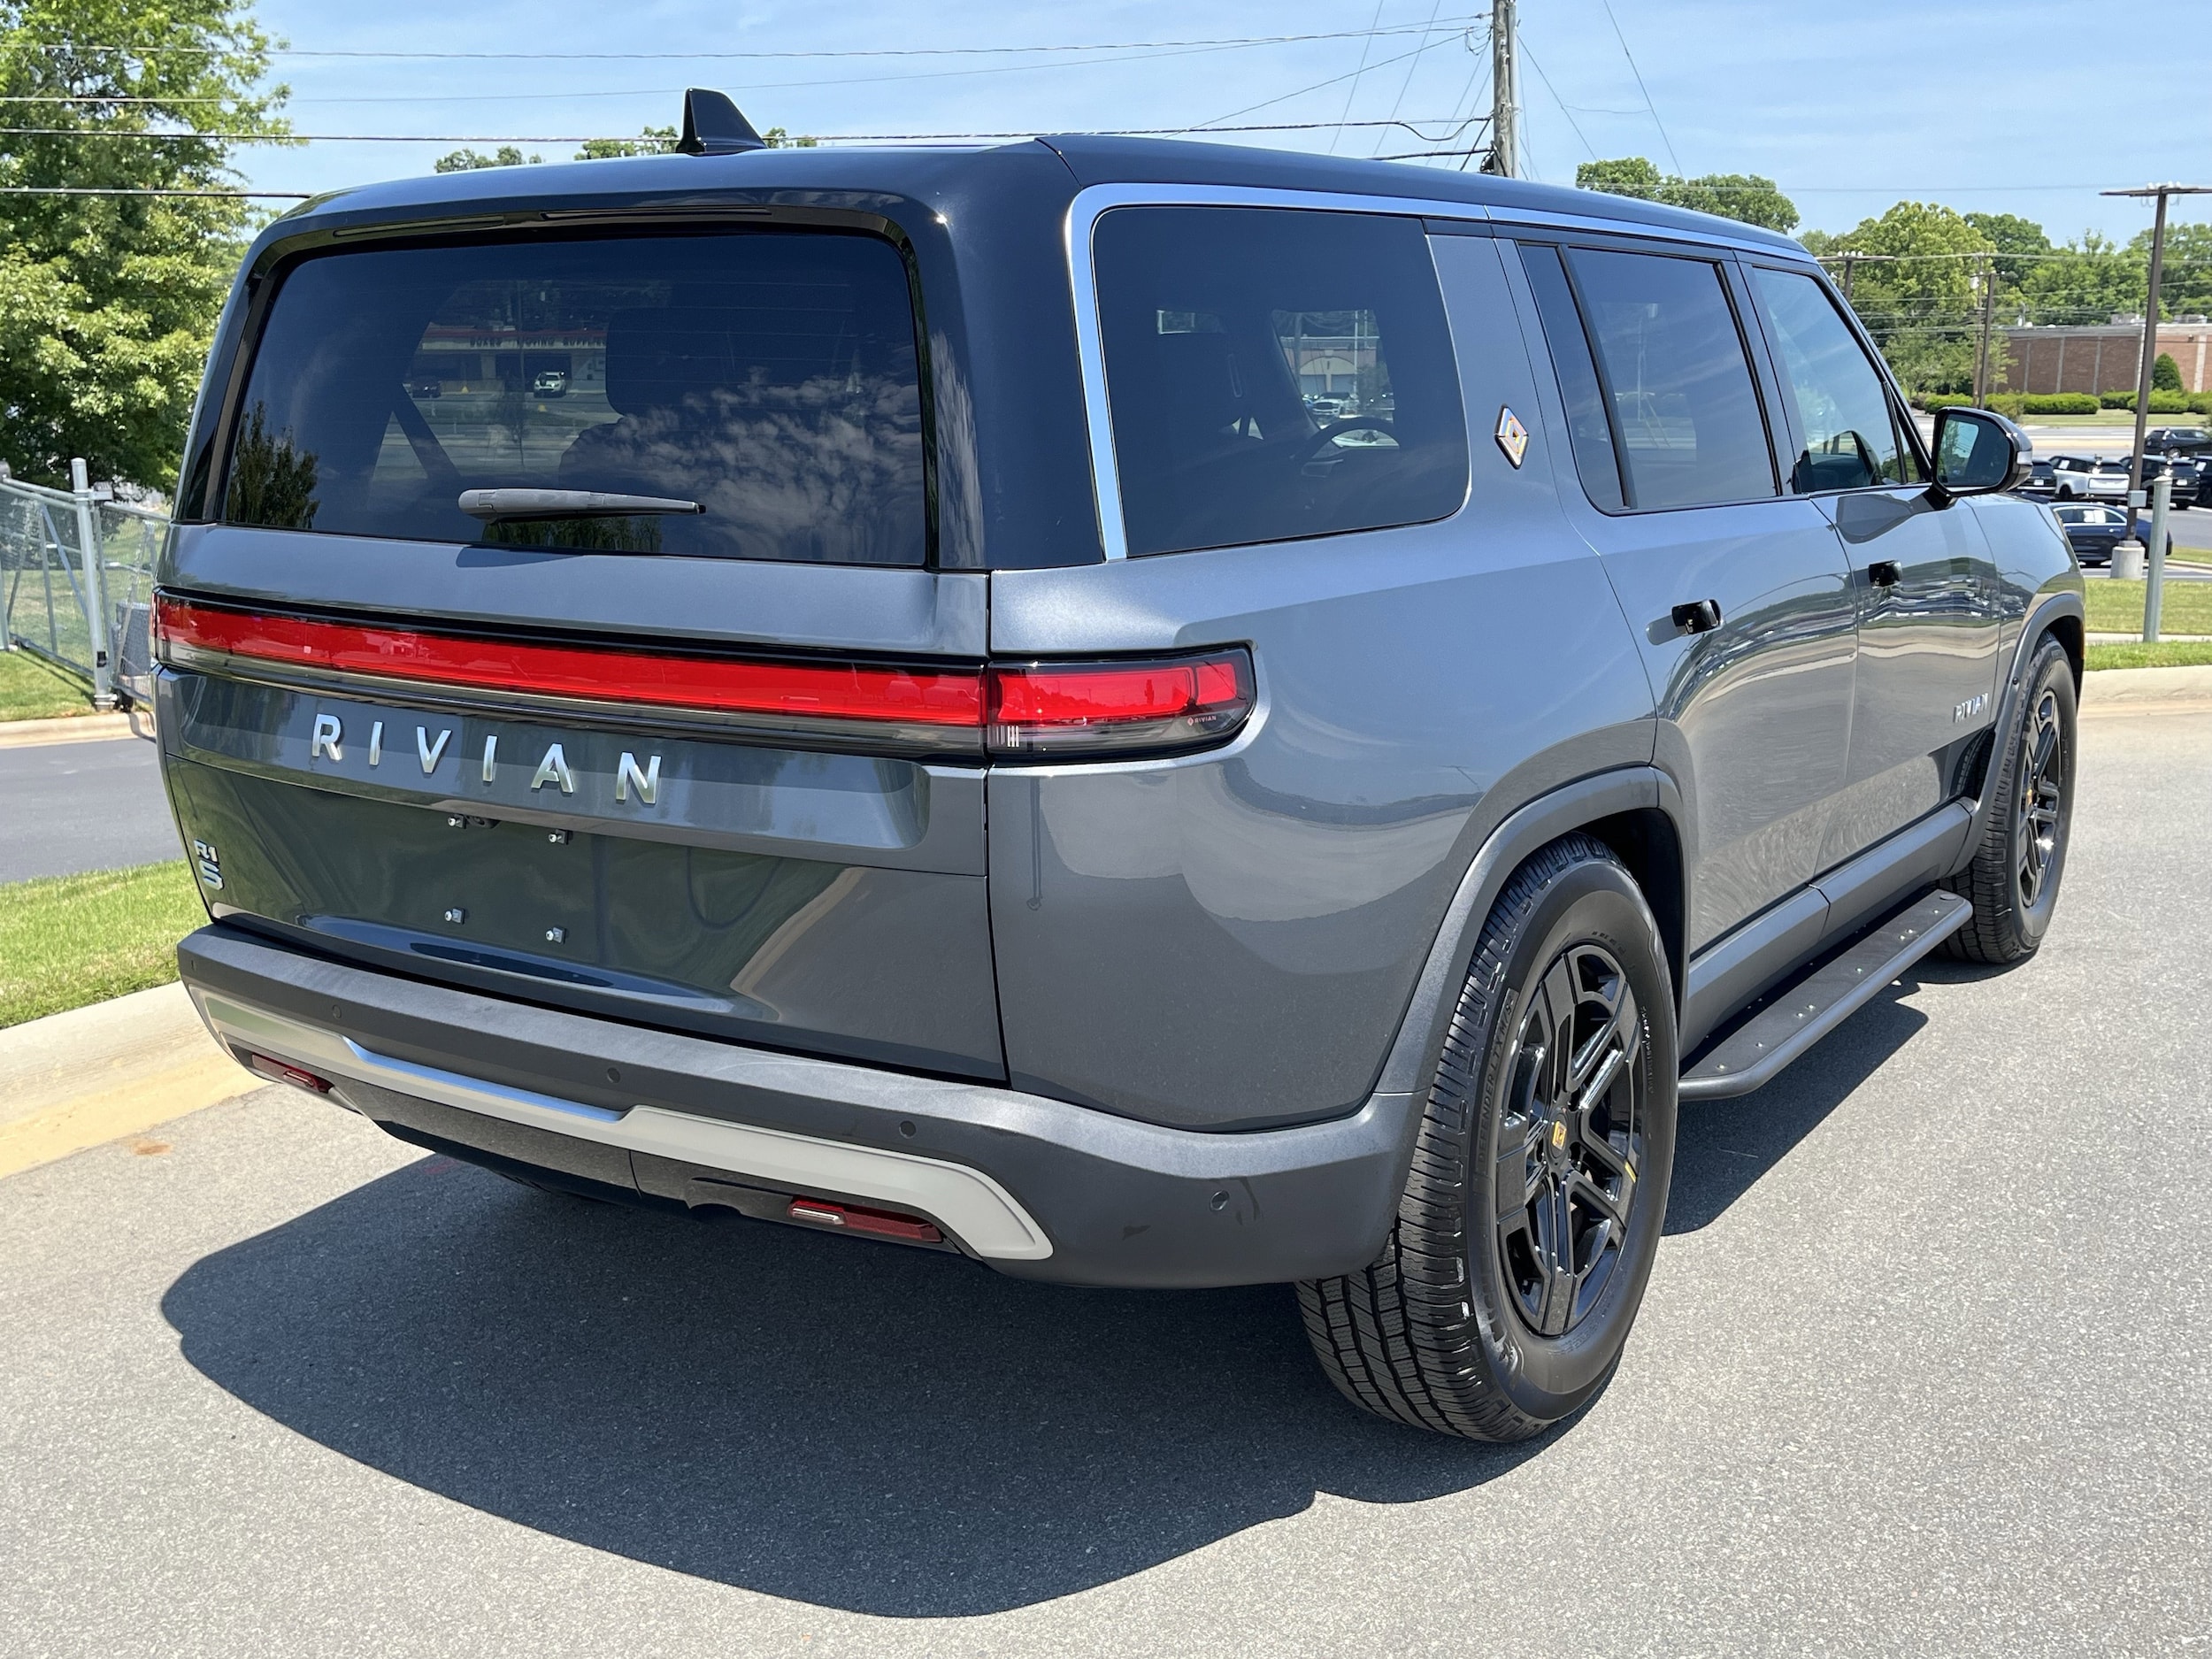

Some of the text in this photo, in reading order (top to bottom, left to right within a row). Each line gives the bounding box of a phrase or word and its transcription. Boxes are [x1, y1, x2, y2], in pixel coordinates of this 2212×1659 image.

[1954, 693, 1988, 723] RIVIAN
[311, 713, 662, 804] RIVIAN
[194, 840, 218, 862] R1
[199, 859, 224, 890] S
[1479, 1075, 1494, 1164] DEFENDER
